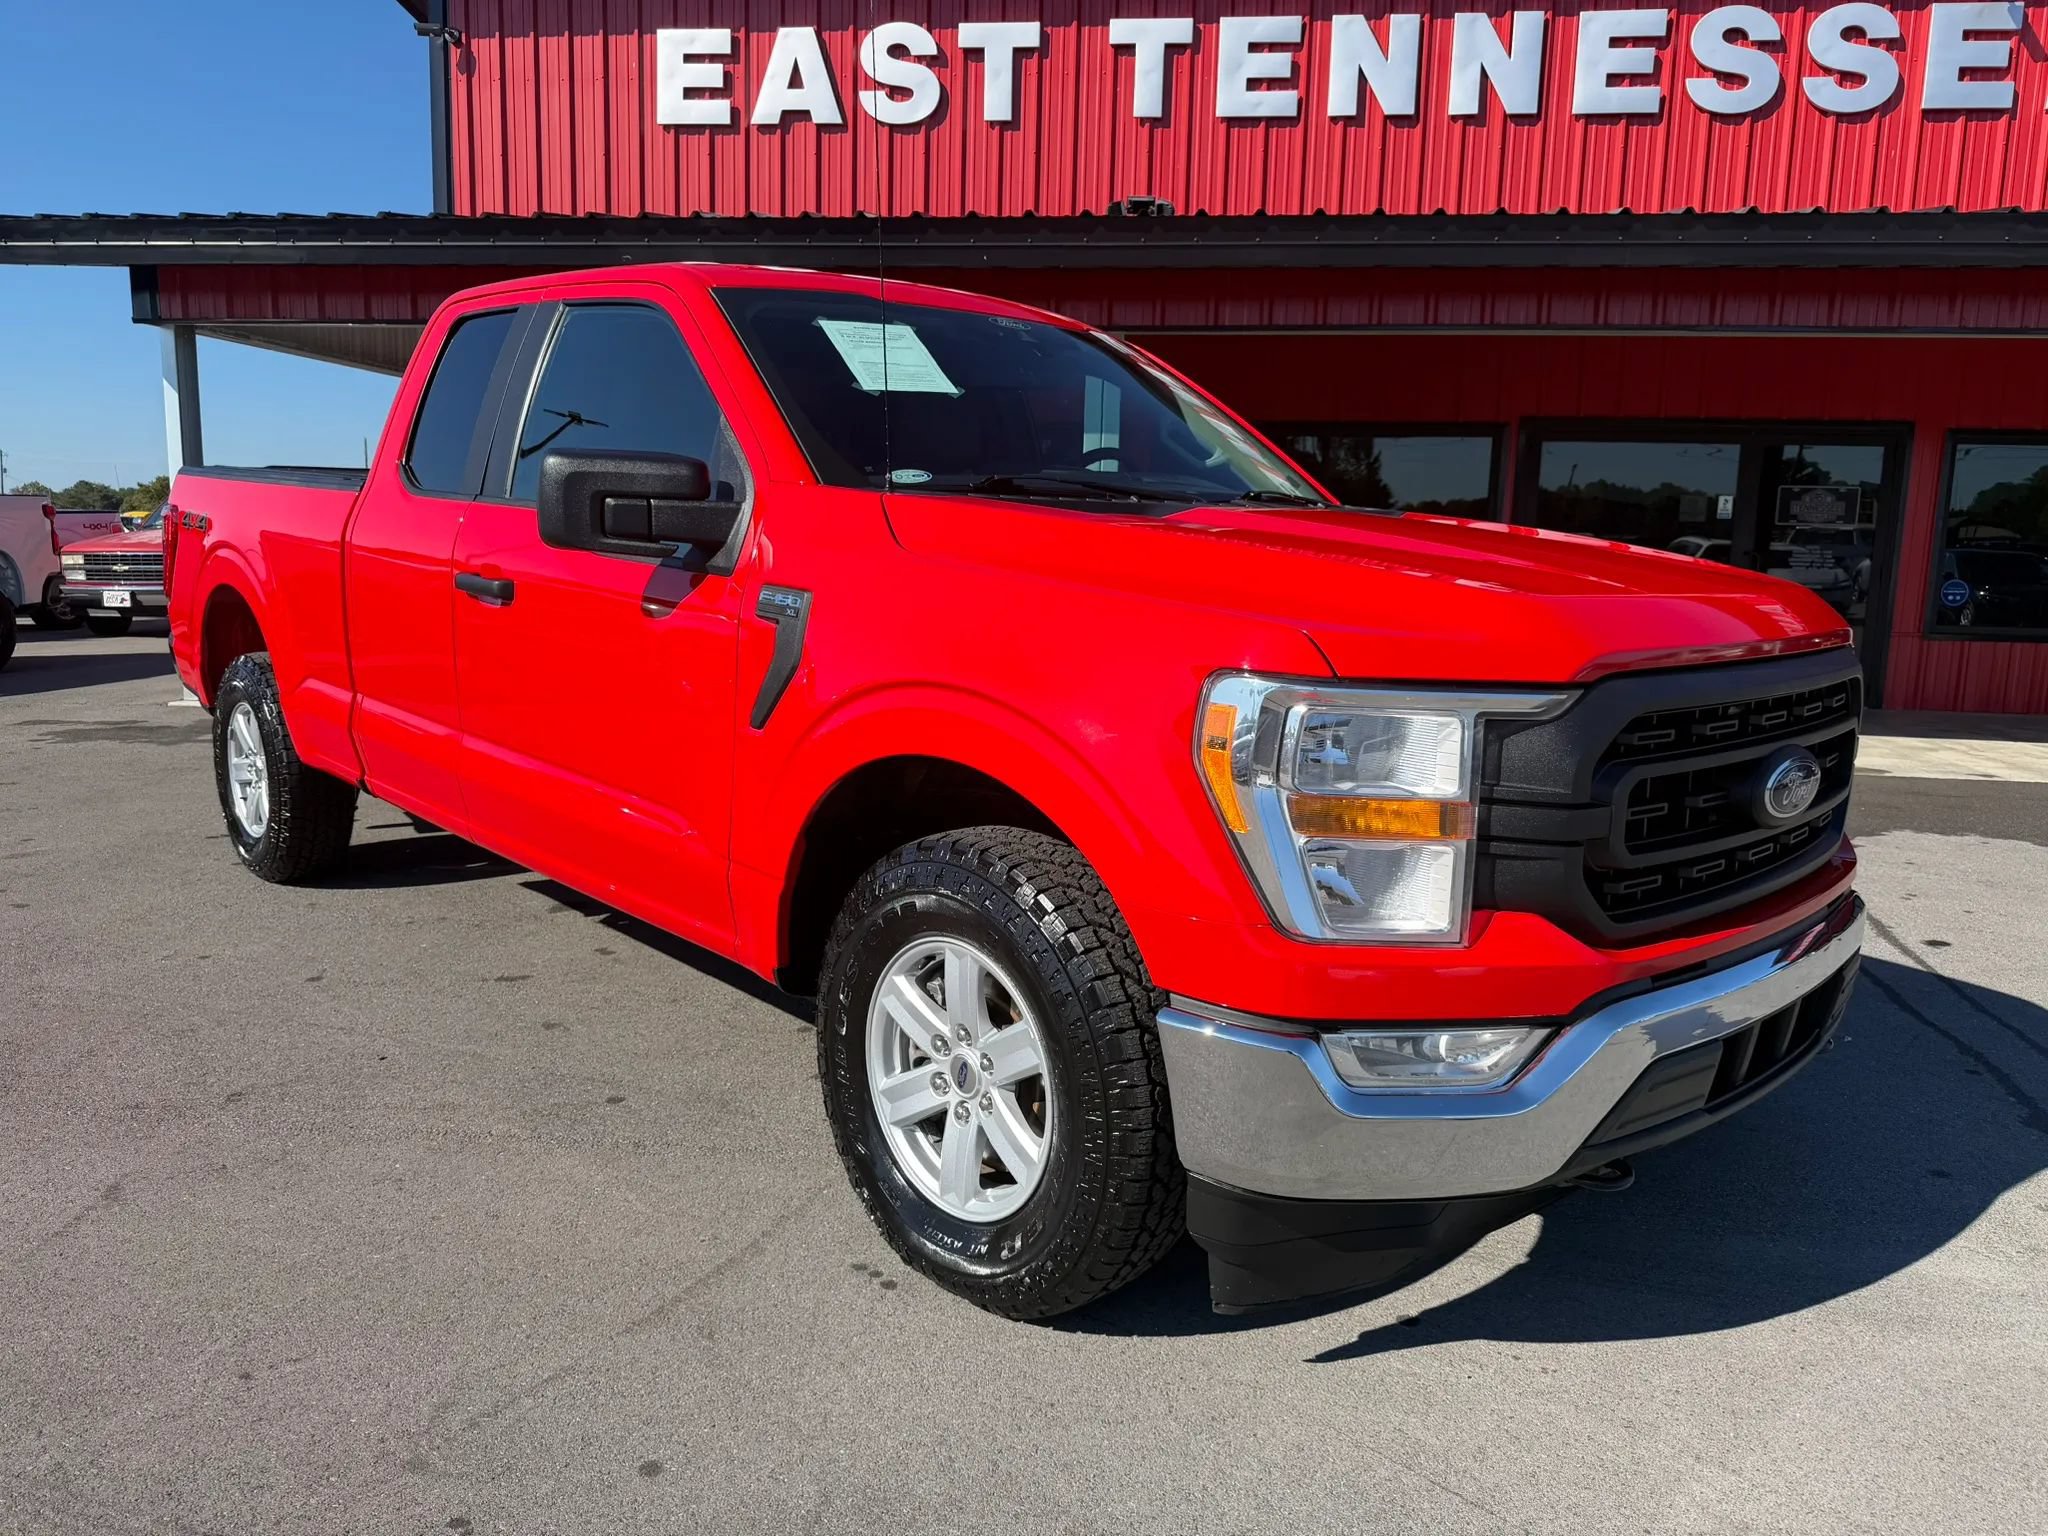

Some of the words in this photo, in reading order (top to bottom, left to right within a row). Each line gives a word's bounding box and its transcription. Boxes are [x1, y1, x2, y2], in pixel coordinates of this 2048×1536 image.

[656, 22, 1040, 125] EAST
[1109, 2, 2047, 120] TENNESSE
[785, 608, 797, 616] XL
